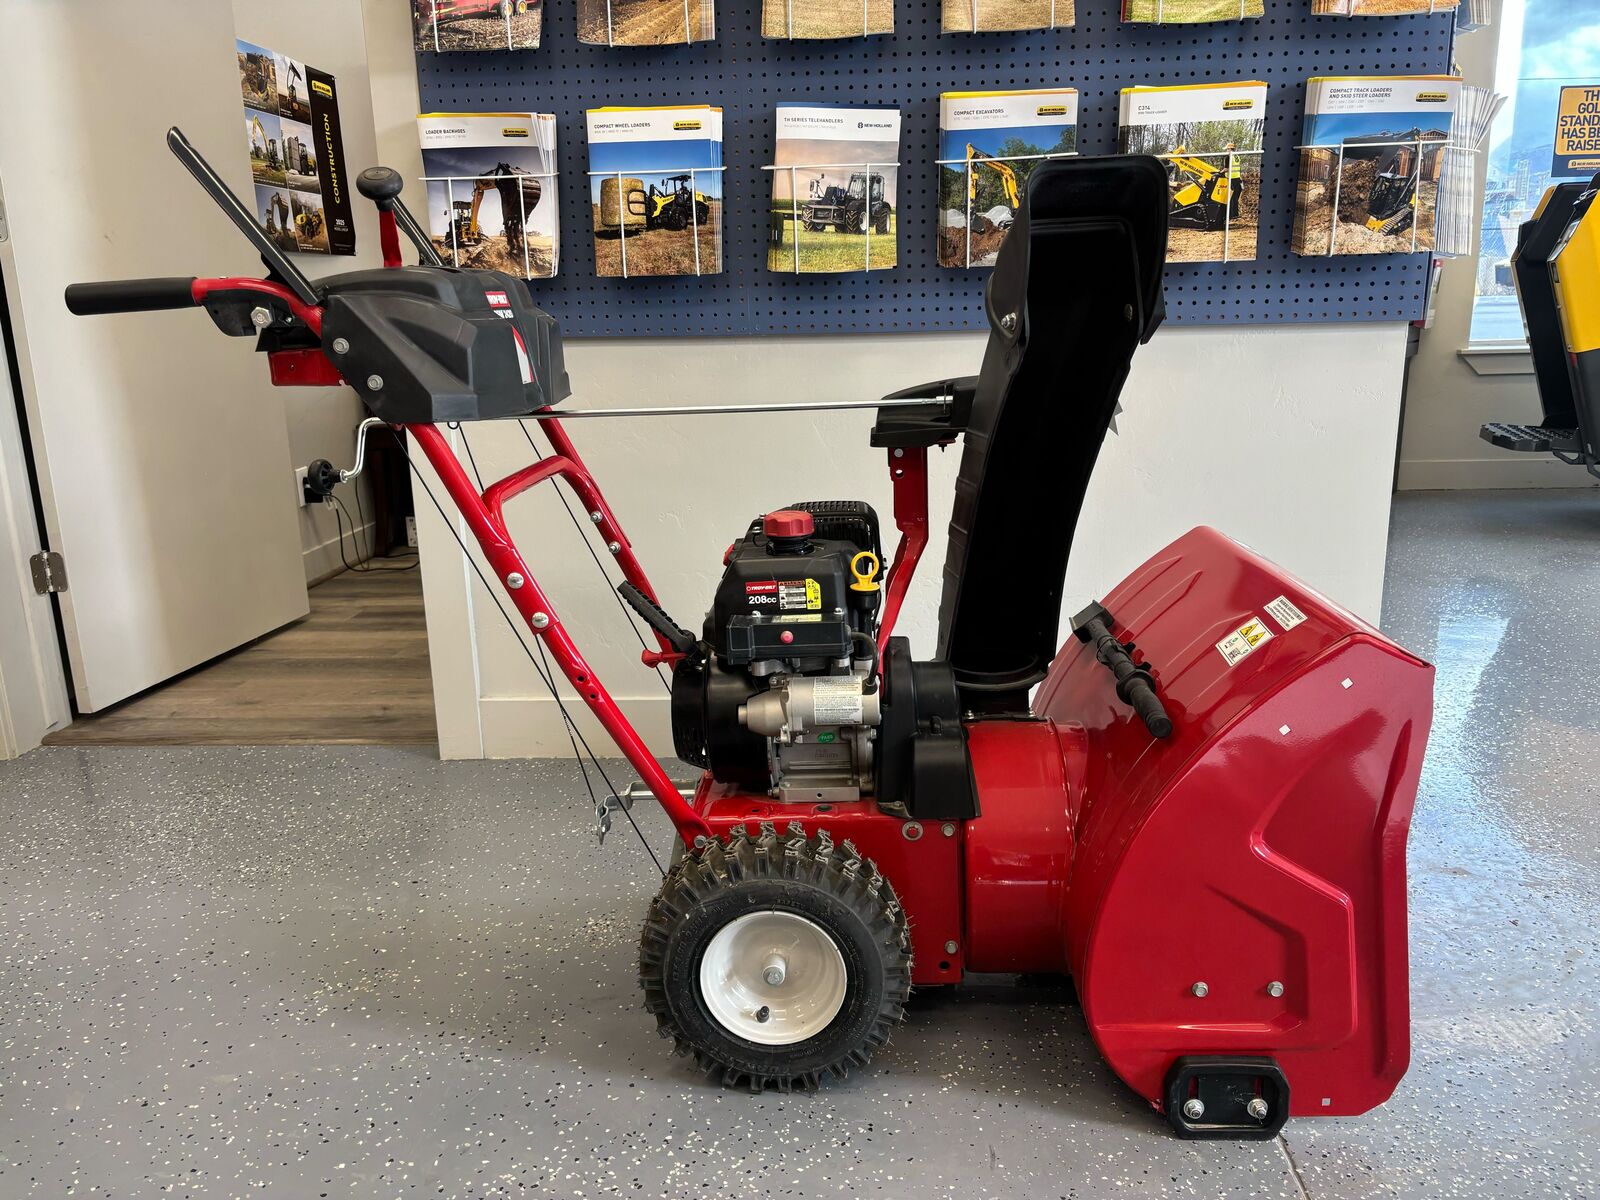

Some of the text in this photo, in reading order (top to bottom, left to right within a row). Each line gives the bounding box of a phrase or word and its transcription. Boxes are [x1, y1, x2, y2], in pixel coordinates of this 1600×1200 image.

[1584, 90, 1600, 102] TH
[1560, 115, 1600, 127] STAND
[1562, 128, 1586, 139] HAS
[1566, 140, 1600, 151] RAISE
[323, 113, 341, 204] CONSTRUCTION
[748, 595, 777, 604] 208cc
